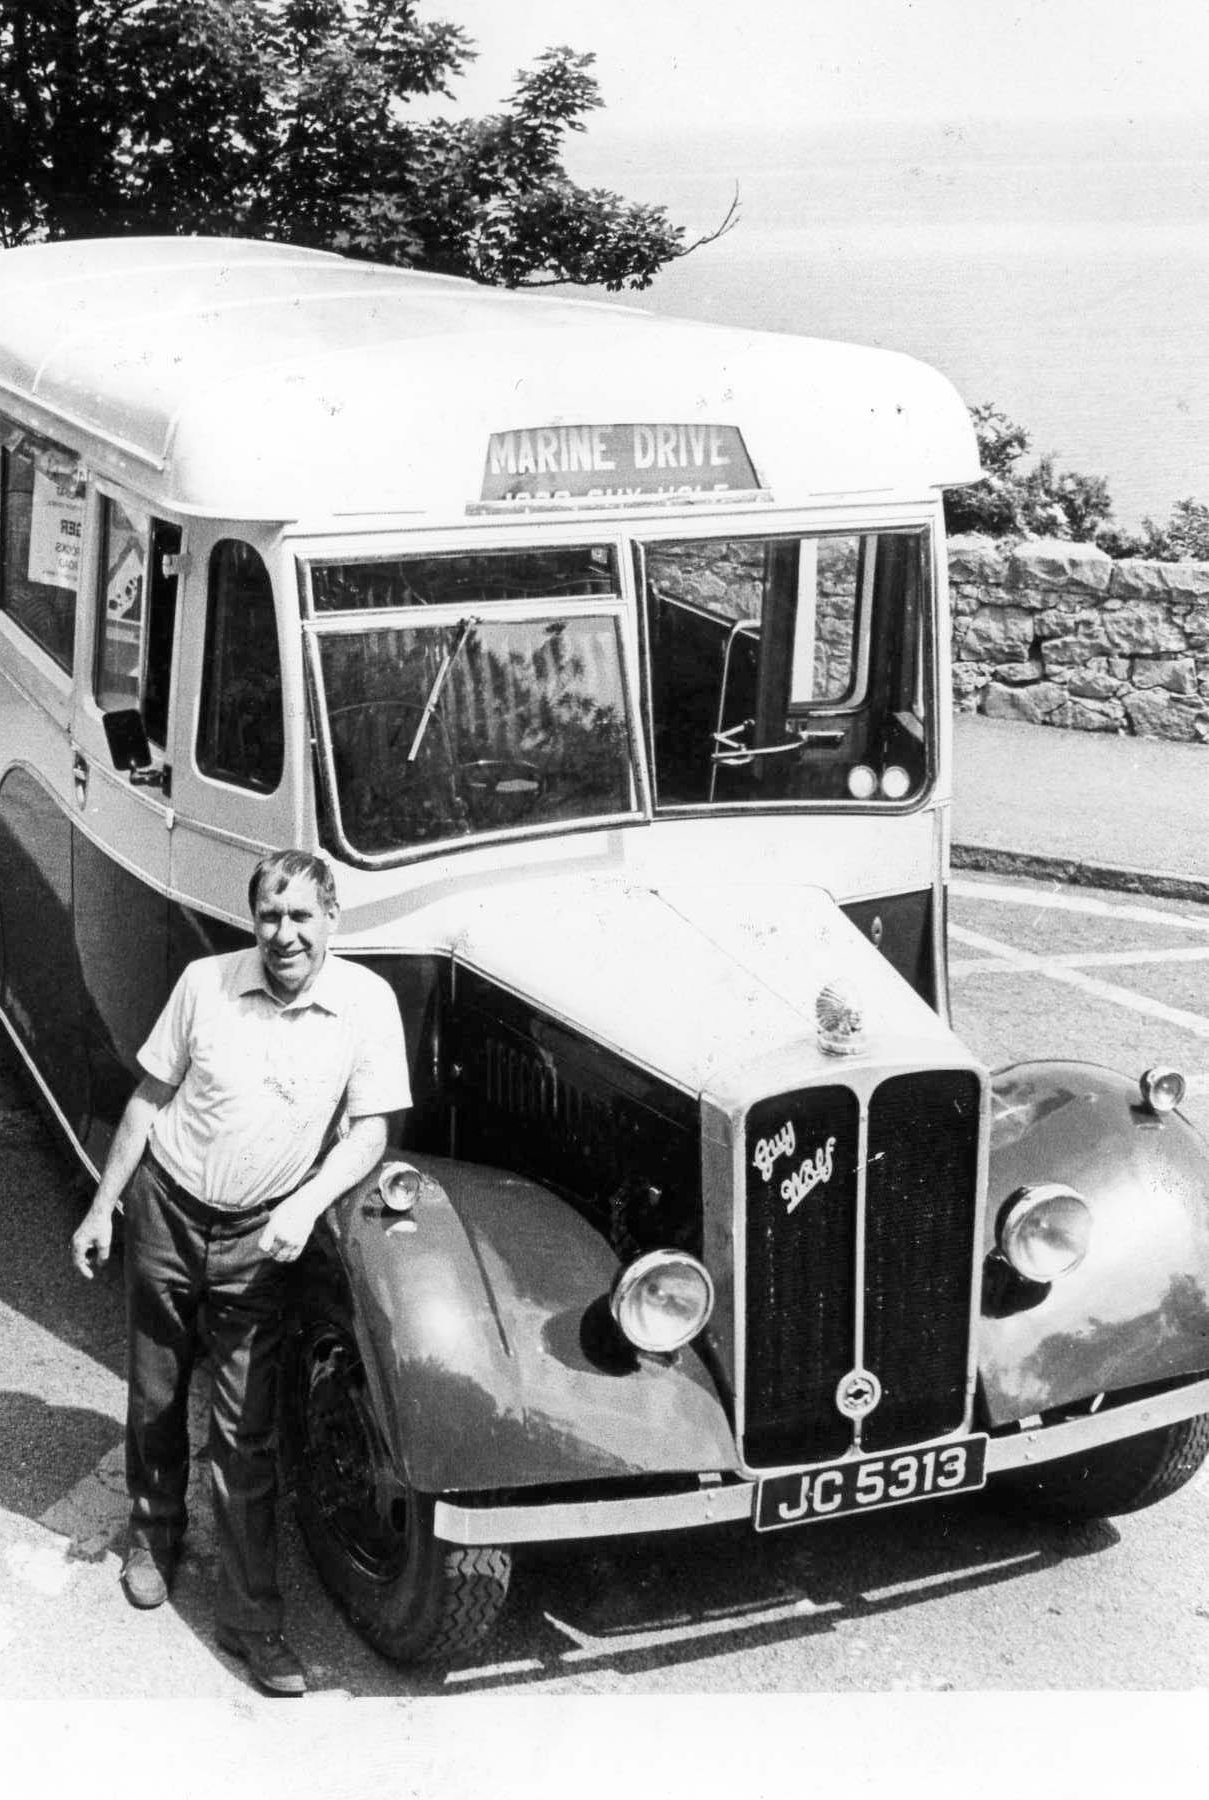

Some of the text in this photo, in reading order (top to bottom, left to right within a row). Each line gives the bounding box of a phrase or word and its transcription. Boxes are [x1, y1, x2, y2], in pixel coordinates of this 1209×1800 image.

[490, 423, 731, 475] MARINE DRIVE
[752, 1120, 796, 1183] Guy
[780, 1136, 837, 1215] Wolf
[778, 1446, 967, 1520] JC 5313
